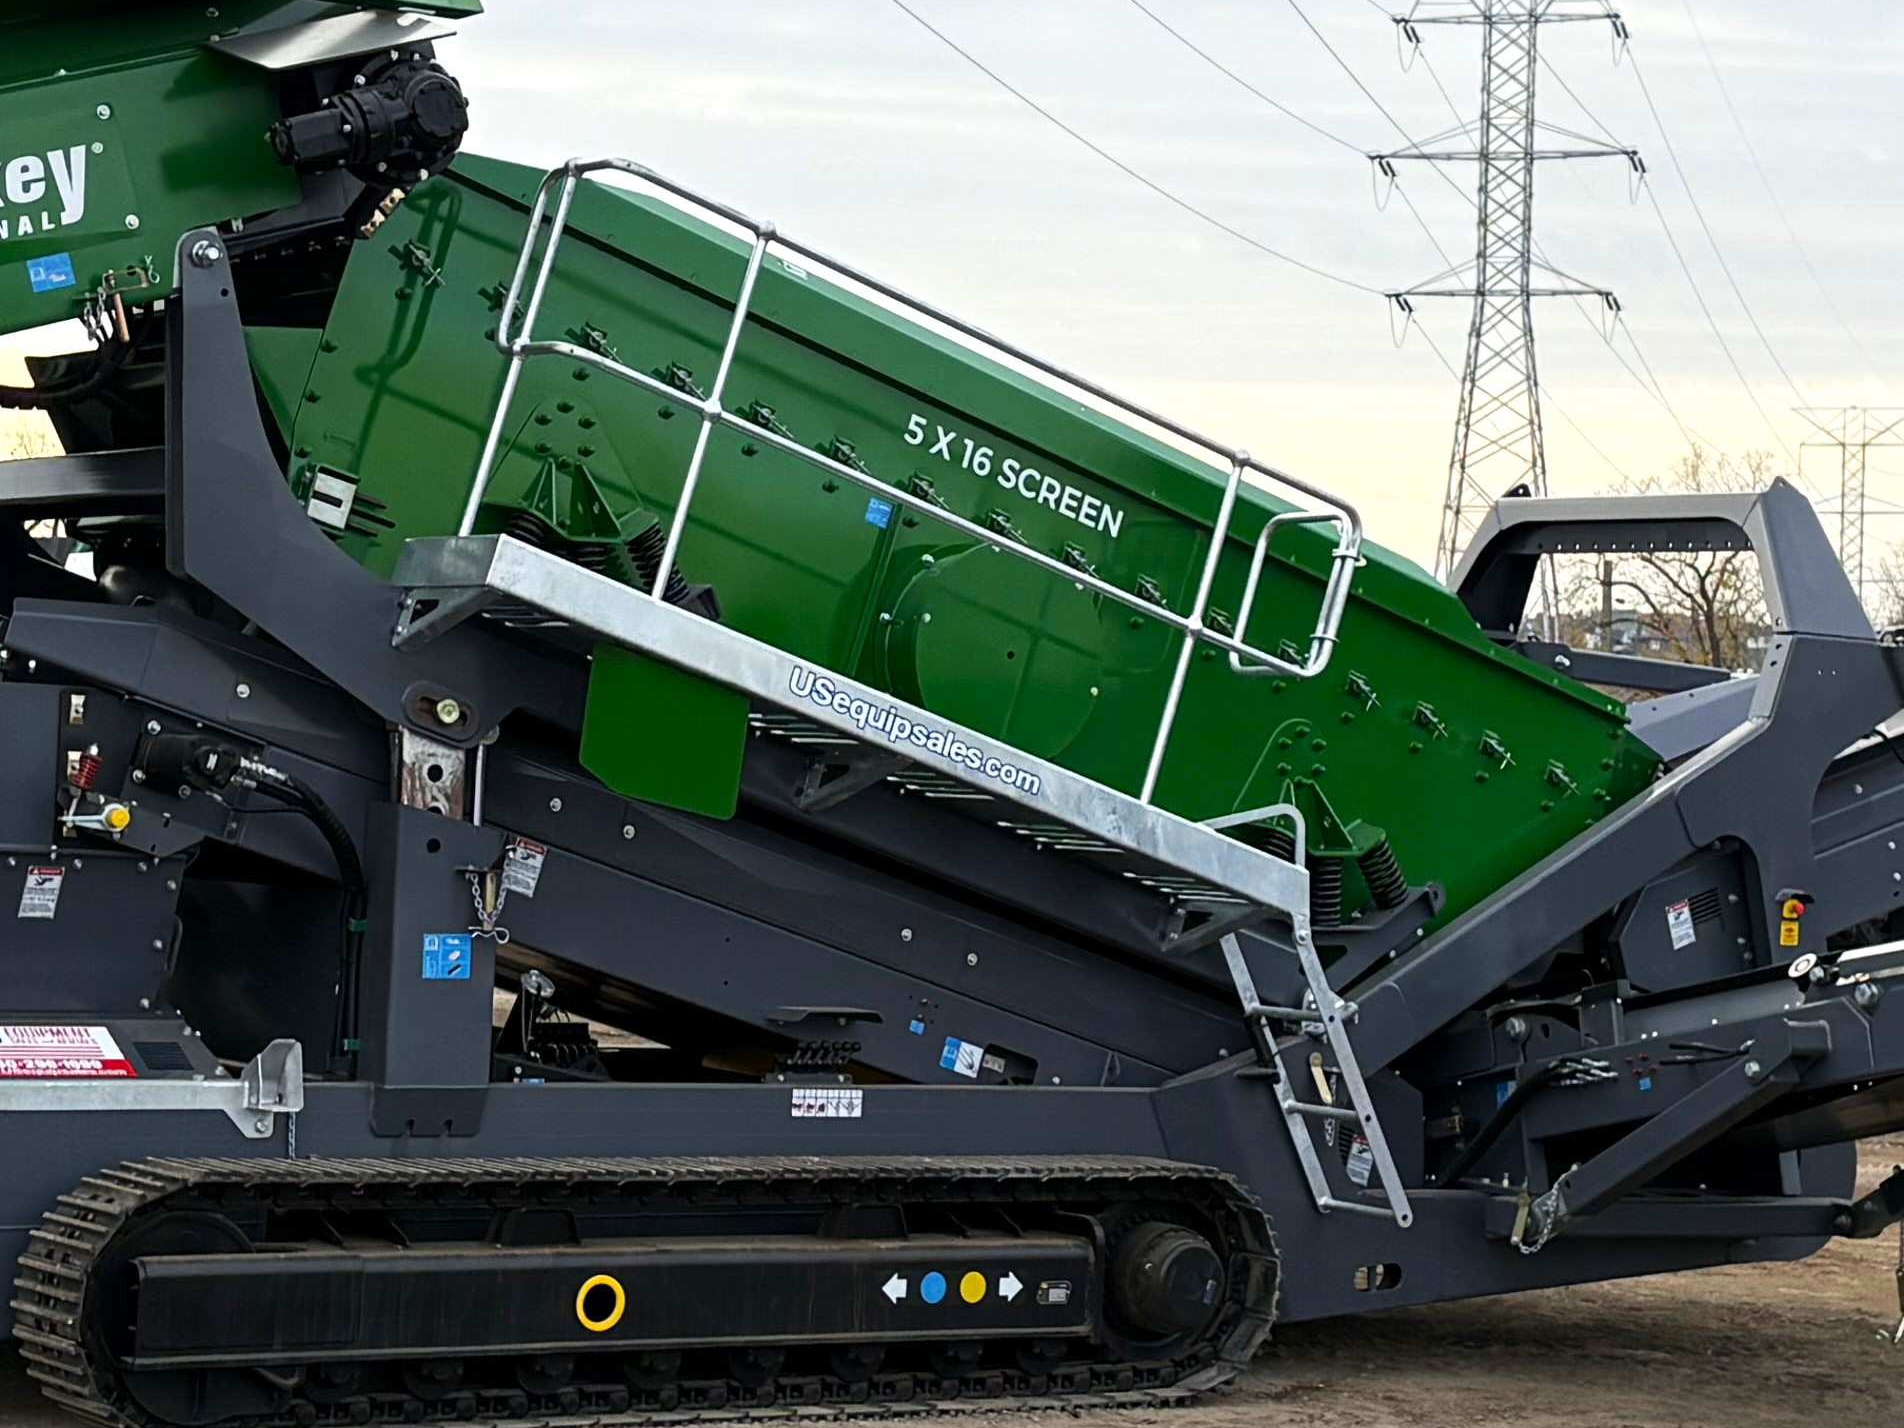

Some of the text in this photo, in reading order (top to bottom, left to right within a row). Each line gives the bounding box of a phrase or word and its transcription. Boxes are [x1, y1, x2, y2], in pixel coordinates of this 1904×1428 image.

[903, 413, 1125, 538] 5 X 16 SCREEN
[788, 664, 1041, 796] USequipsales.com
